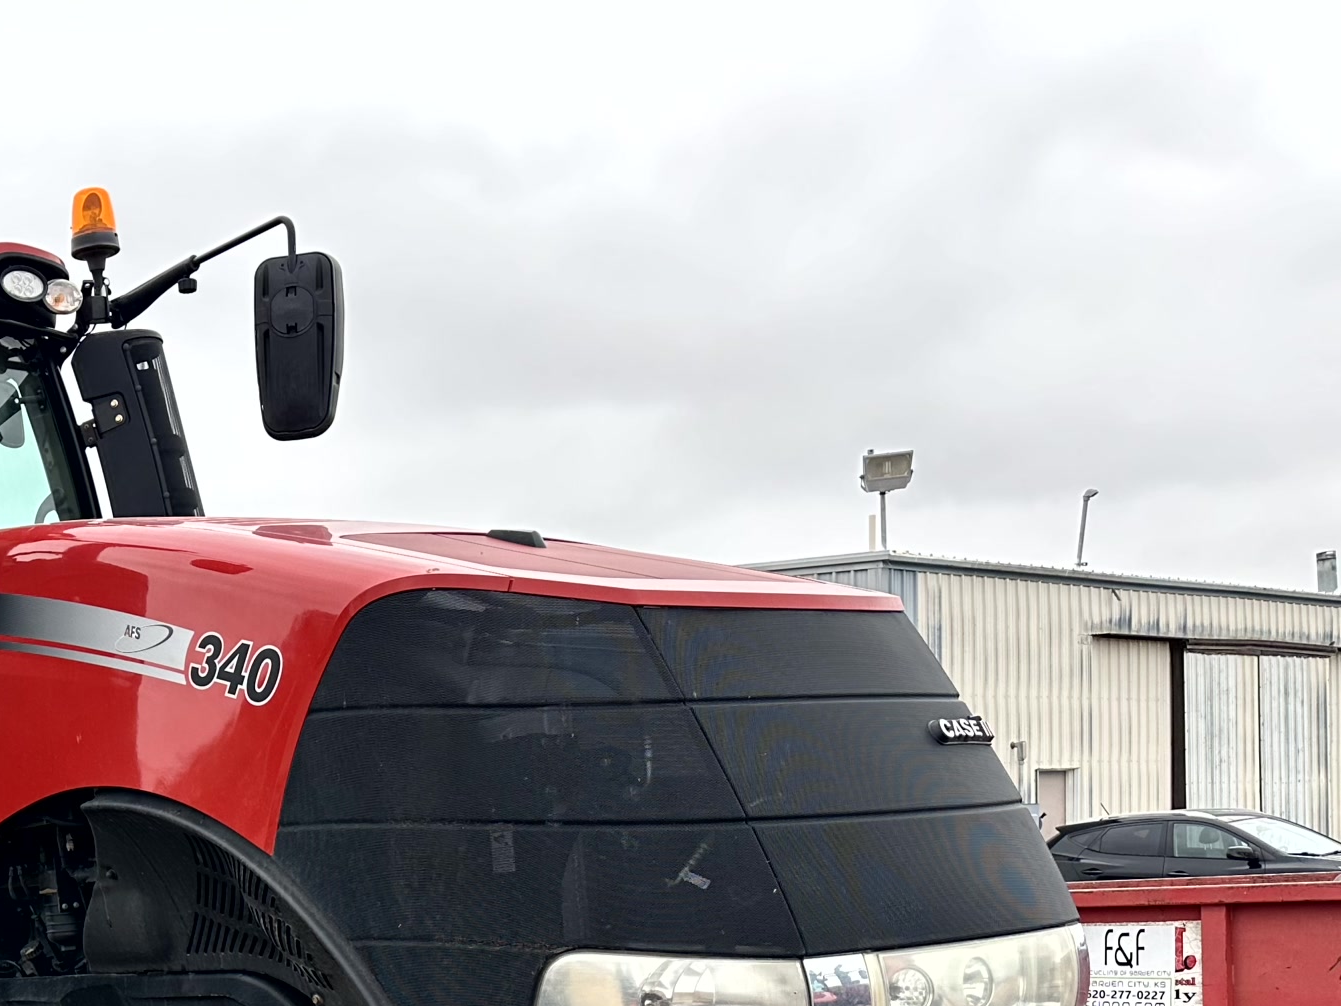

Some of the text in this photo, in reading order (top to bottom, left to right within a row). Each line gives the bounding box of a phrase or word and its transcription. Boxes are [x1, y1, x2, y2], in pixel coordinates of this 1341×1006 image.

[124, 624, 141, 640] AFS
[189, 631, 283, 706] 340
[940, 719, 983, 737] CASE
[1091, 980, 1124, 988] ARDEN
[1154, 981, 1167, 989] KS
[1174, 989, 1197, 1004] ly
